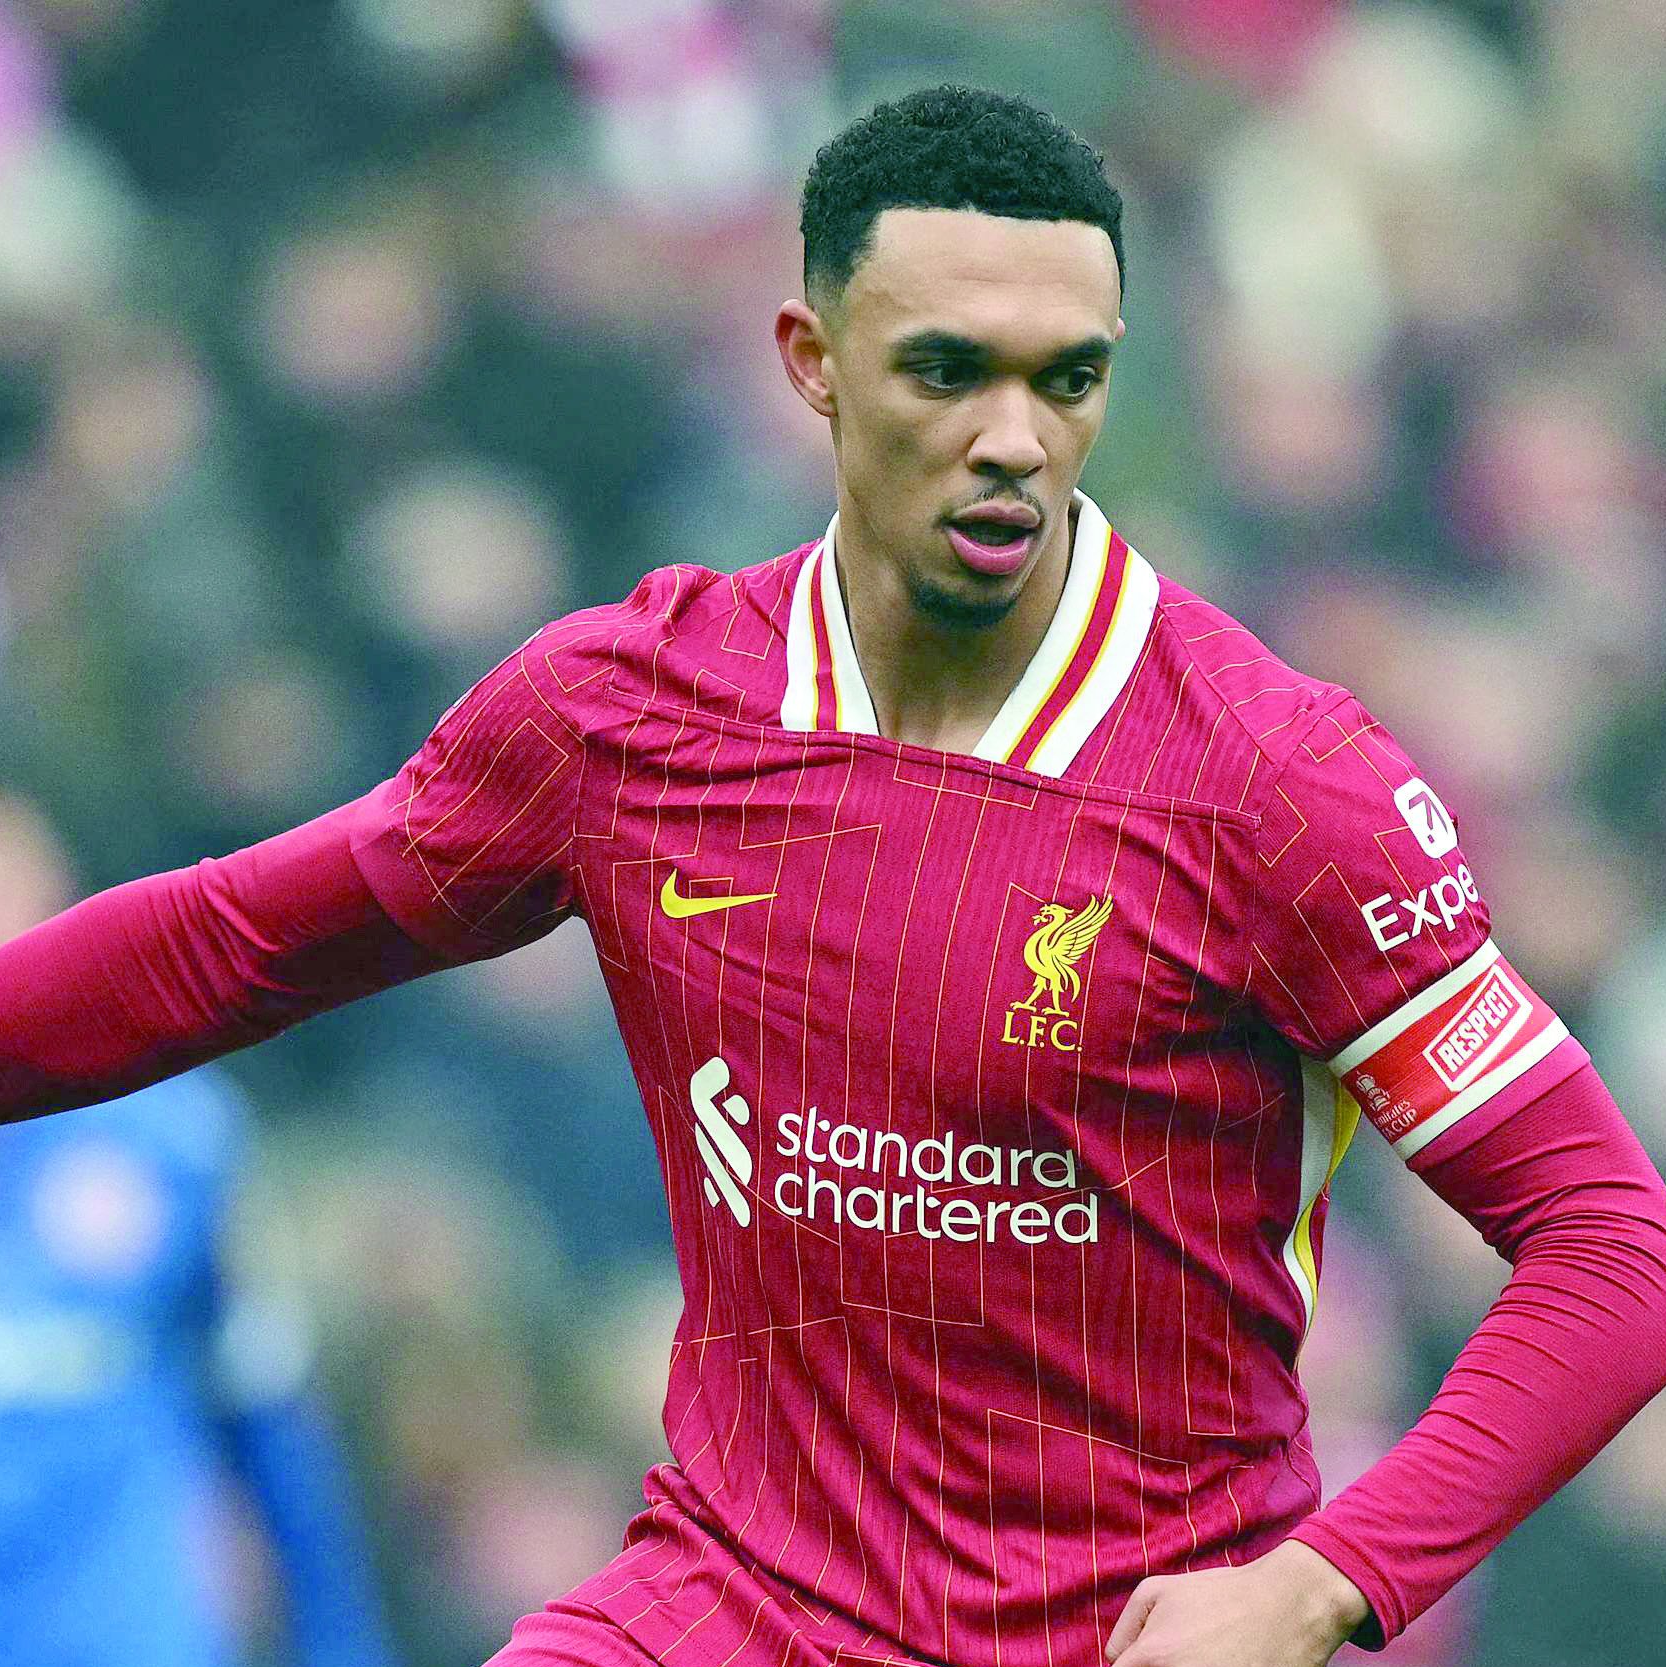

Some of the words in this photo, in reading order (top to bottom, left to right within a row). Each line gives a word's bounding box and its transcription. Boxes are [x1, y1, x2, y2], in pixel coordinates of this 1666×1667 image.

[1361, 864, 1479, 952] Expe
[1001, 1010, 1083, 1053] L.F.C.
[1436, 982, 1514, 1074] RESPECT
[776, 1105, 1077, 1189] standard
[1391, 1108, 1418, 1133] CUP
[774, 1166, 1100, 1245] chartered
